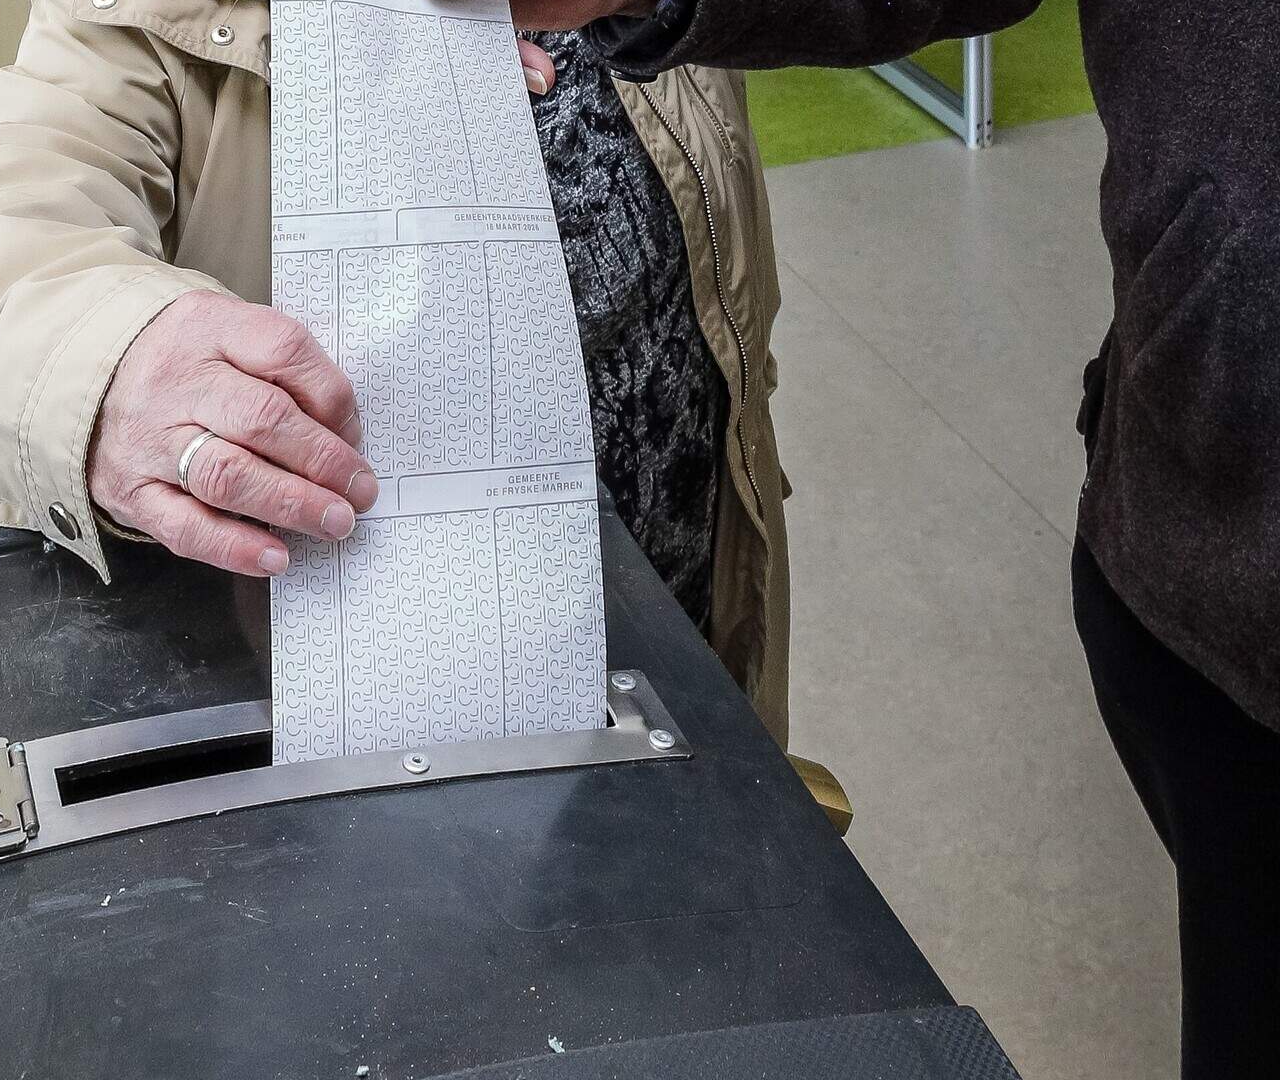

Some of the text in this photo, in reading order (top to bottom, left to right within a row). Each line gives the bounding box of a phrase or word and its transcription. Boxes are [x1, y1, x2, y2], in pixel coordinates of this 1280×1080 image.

[495, 223, 521, 231] MAART
[508, 471, 561, 484] GEMEENTE
[486, 480, 583, 497] DE FRYSKE MARREN
